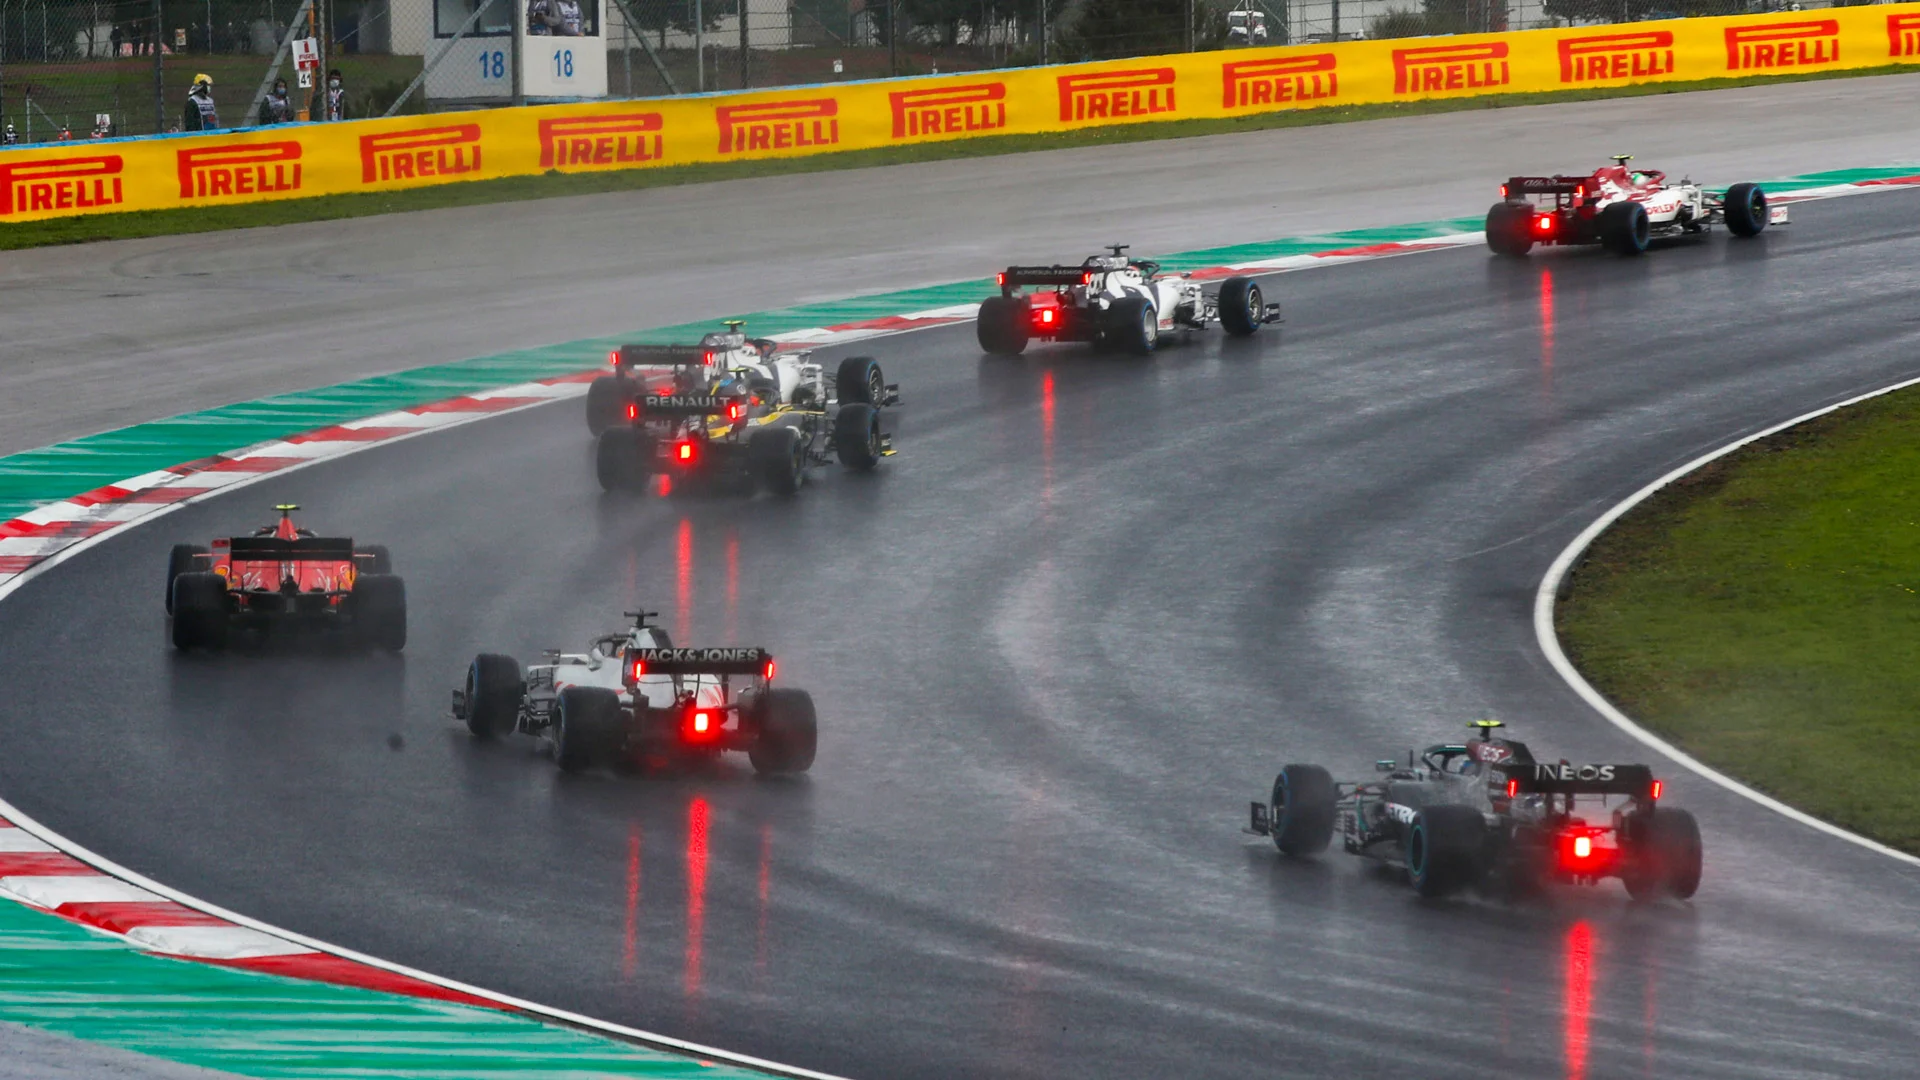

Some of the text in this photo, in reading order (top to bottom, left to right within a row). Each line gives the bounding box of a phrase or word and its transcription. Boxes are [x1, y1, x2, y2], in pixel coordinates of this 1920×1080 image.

[479, 50, 505, 78] 18
[553, 49, 573, 77] 18
[1392, 42, 1509, 93] PIRELLI
[1558, 31, 1673, 82] PIRELLI
[1725, 19, 1839, 70] PIRELLI
[1057, 68, 1176, 121] PIRELLI
[1223, 53, 1337, 108] PIRELLI
[716, 98, 838, 153] PIRELLI
[889, 82, 1006, 138] PIRELLI
[359, 124, 481, 183] PIRELLI
[538, 113, 663, 167] PIRELLI
[0, 155, 123, 215] PIRELLI
[177, 141, 302, 199] PIRELLI
[646, 396, 730, 407] RENAULT
[701, 648, 759, 661] JONES
[1534, 764, 1615, 780] INEOS
